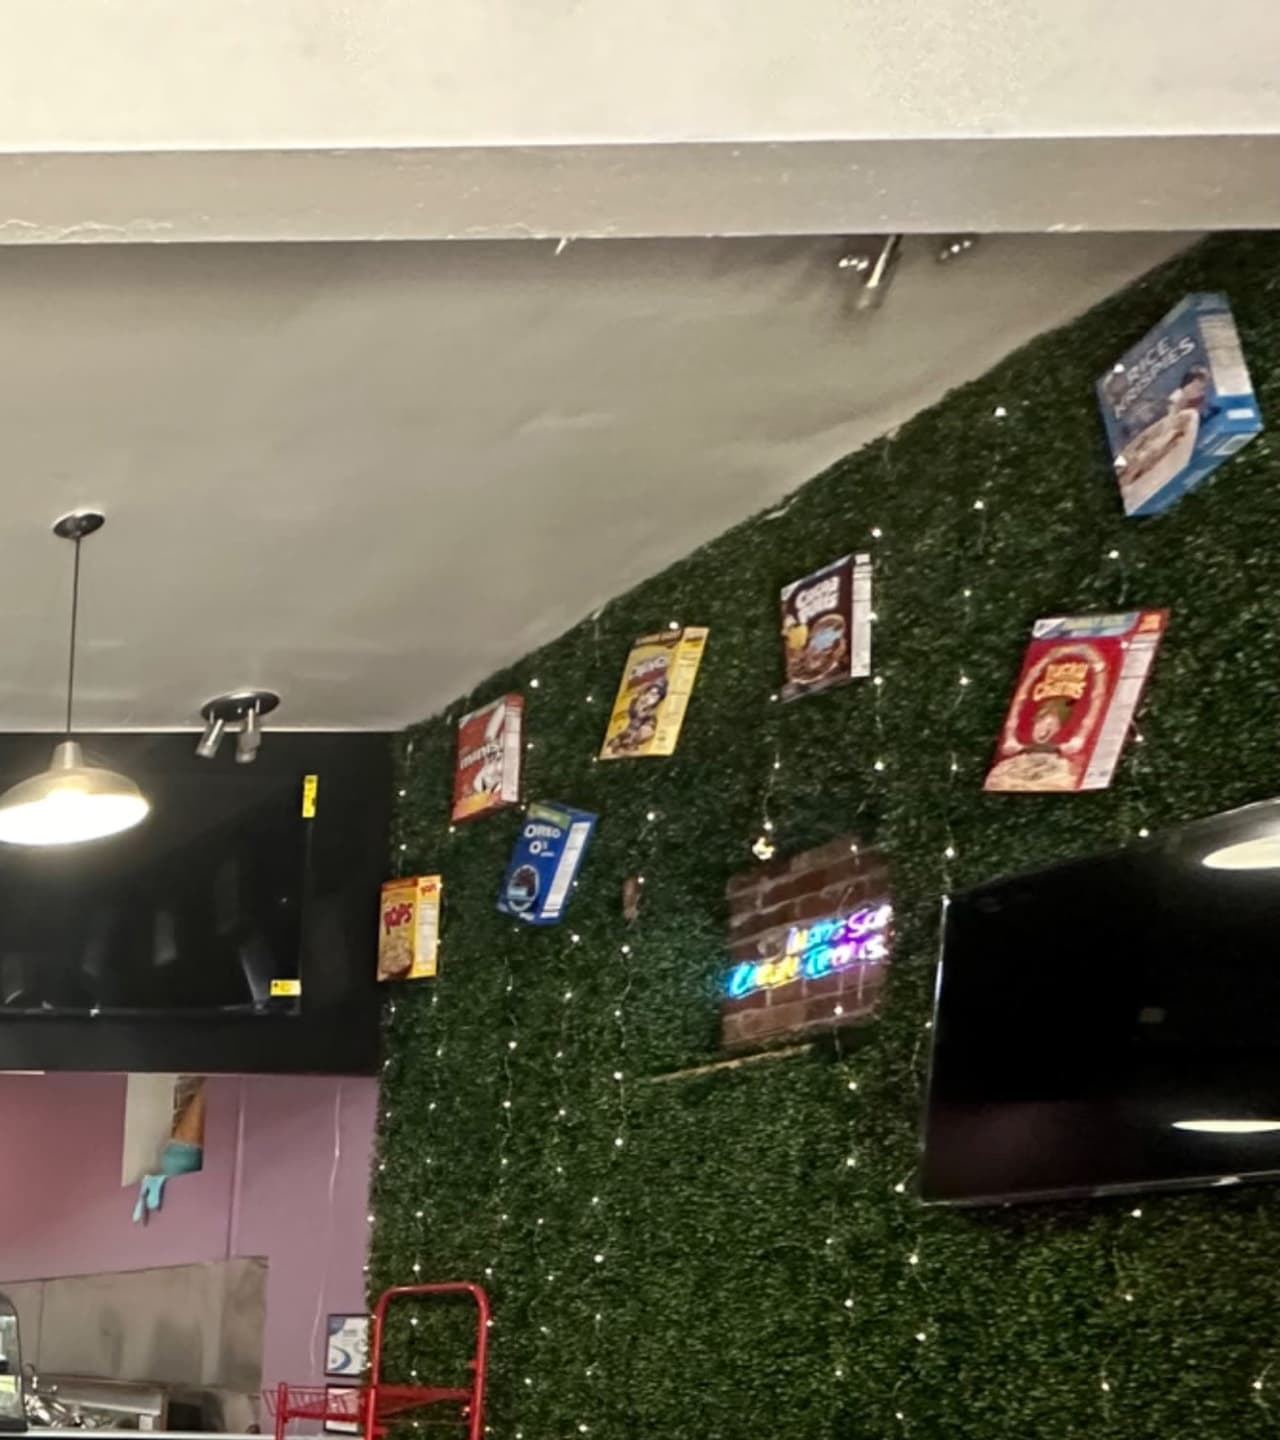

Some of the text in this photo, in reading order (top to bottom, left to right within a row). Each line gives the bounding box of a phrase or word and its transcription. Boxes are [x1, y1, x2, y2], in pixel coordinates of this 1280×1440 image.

[1113, 337, 1196, 420] KRISPIES
[1126, 336, 1171, 384] RICE
[523, 823, 562, 839] OREO
[383, 902, 414, 936] POPS
